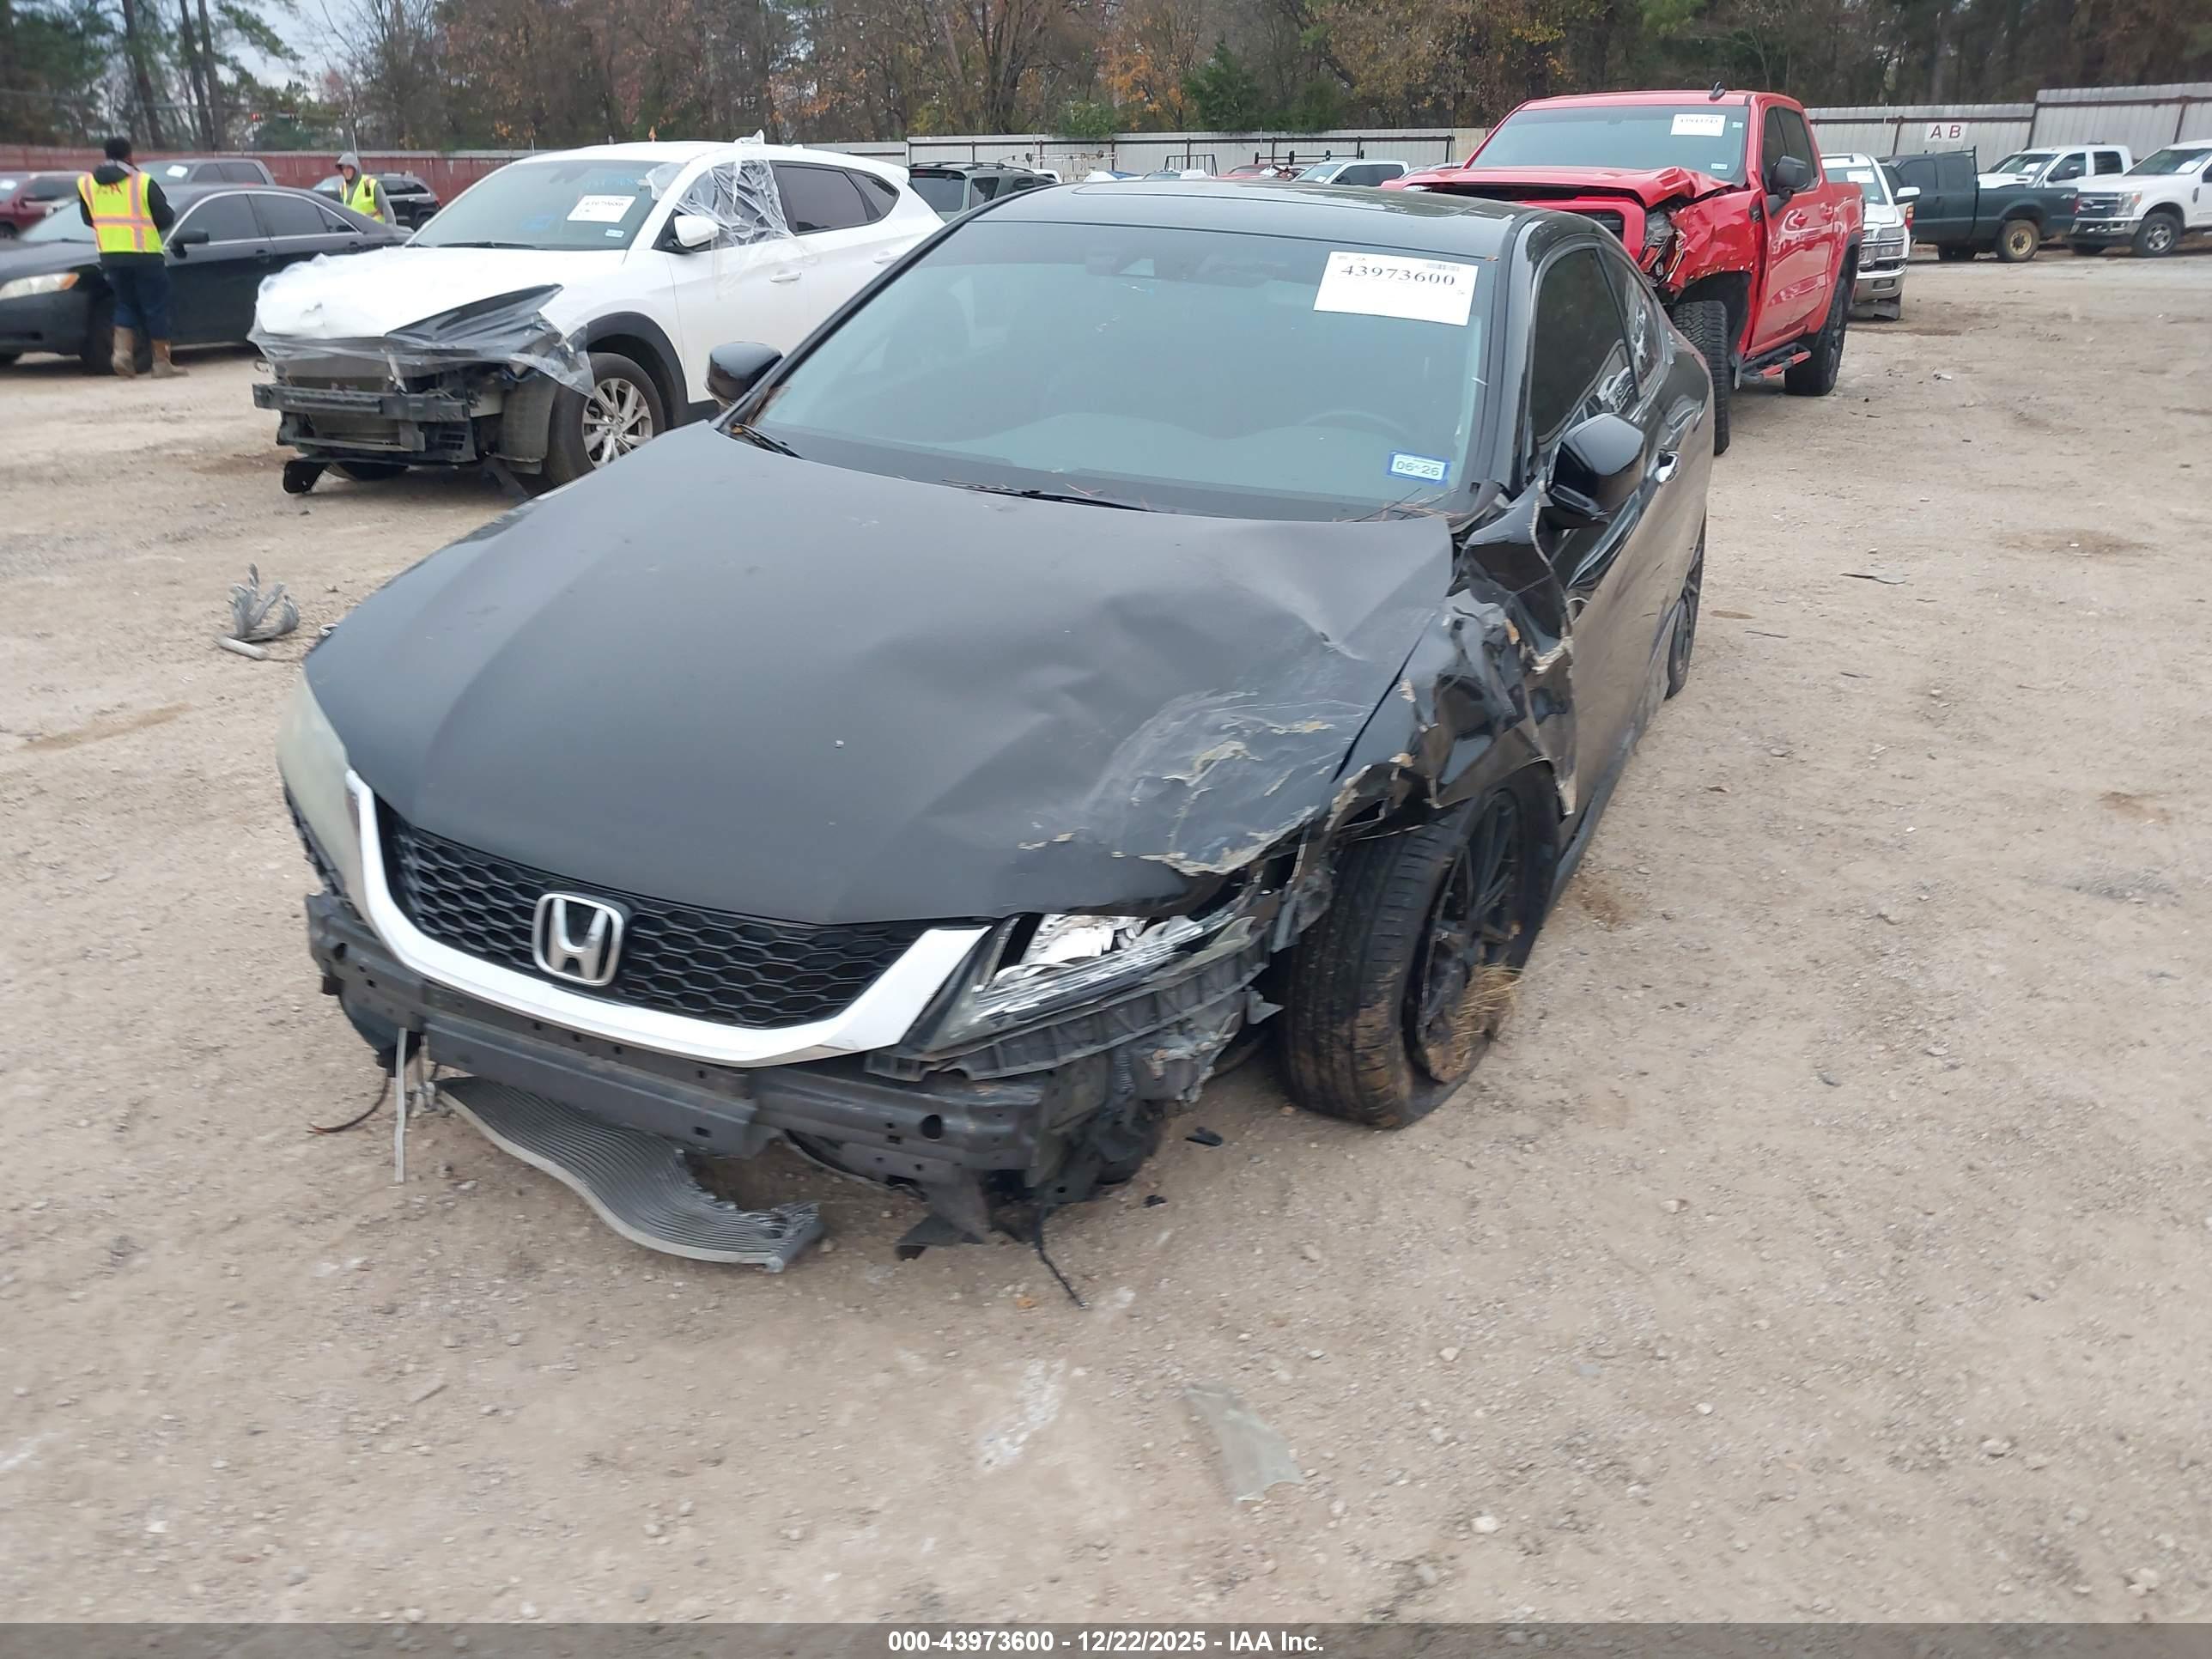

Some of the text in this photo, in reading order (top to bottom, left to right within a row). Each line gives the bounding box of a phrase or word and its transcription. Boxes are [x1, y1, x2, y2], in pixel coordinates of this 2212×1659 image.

[1929, 125, 1961, 139] A B
[1340, 264, 1456, 287] 43973600
[1395, 460, 1441, 477] 06-26
